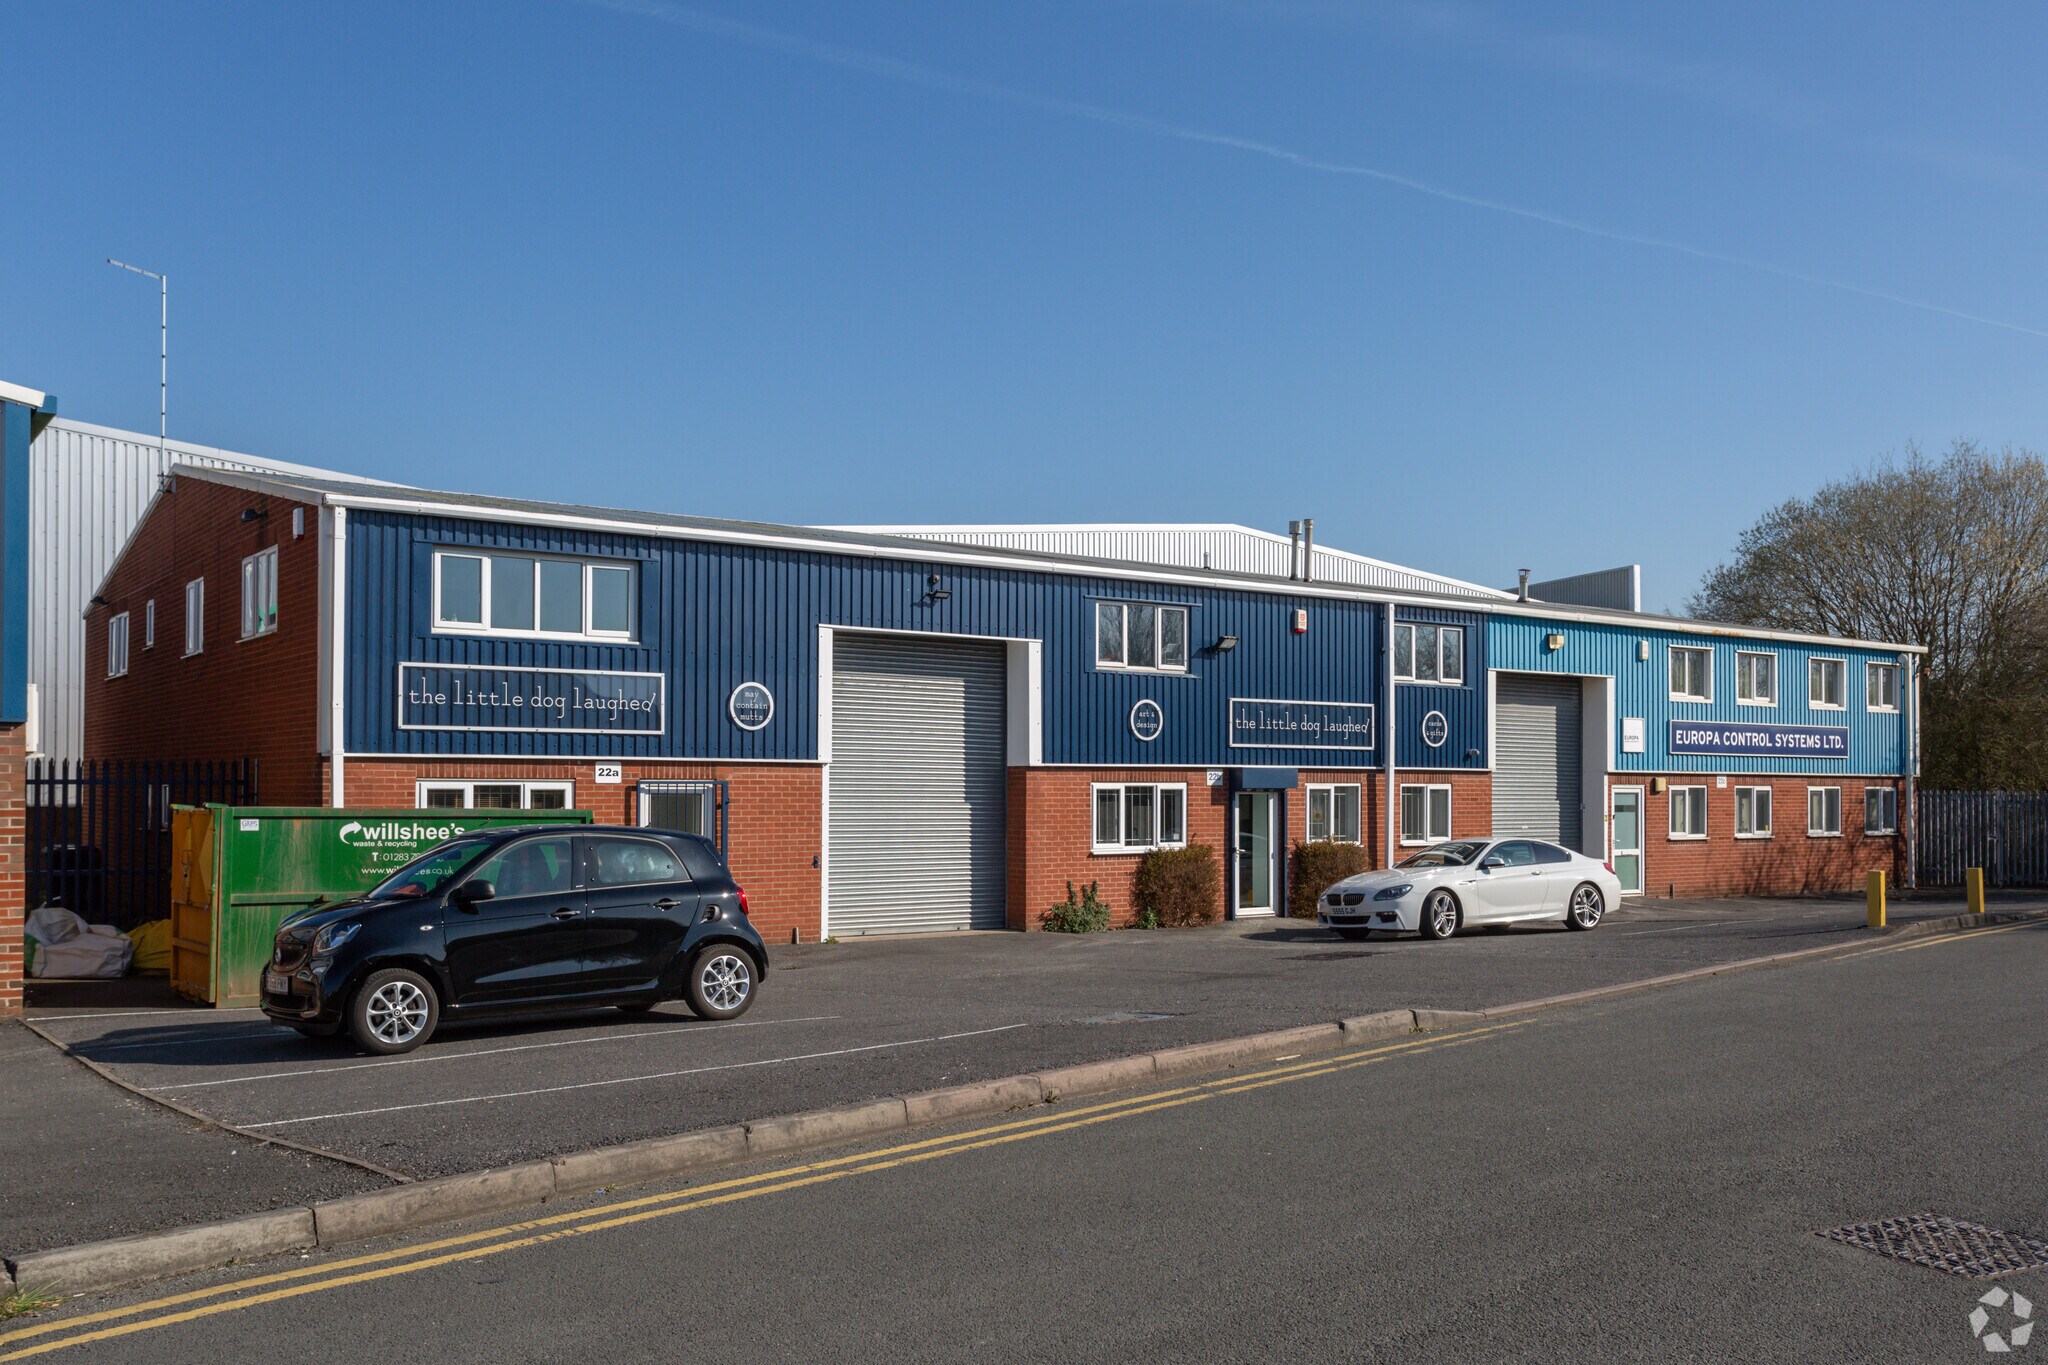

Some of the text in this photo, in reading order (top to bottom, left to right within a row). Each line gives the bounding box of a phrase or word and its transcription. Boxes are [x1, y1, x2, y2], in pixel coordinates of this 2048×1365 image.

[409, 677, 656, 720] the little dog laughed
[744, 692, 759, 702] may
[736, 700, 768, 709] contain
[740, 710, 764, 720] mutts
[1136, 719, 1158, 732] design
[1235, 708, 1370, 740] the little dog laughed
[1675, 730, 1844, 749] EUROPA CONTROL SYSTEMS LTD.
[598, 767, 619, 777] 22a
[385, 840, 417, 848] recycling
